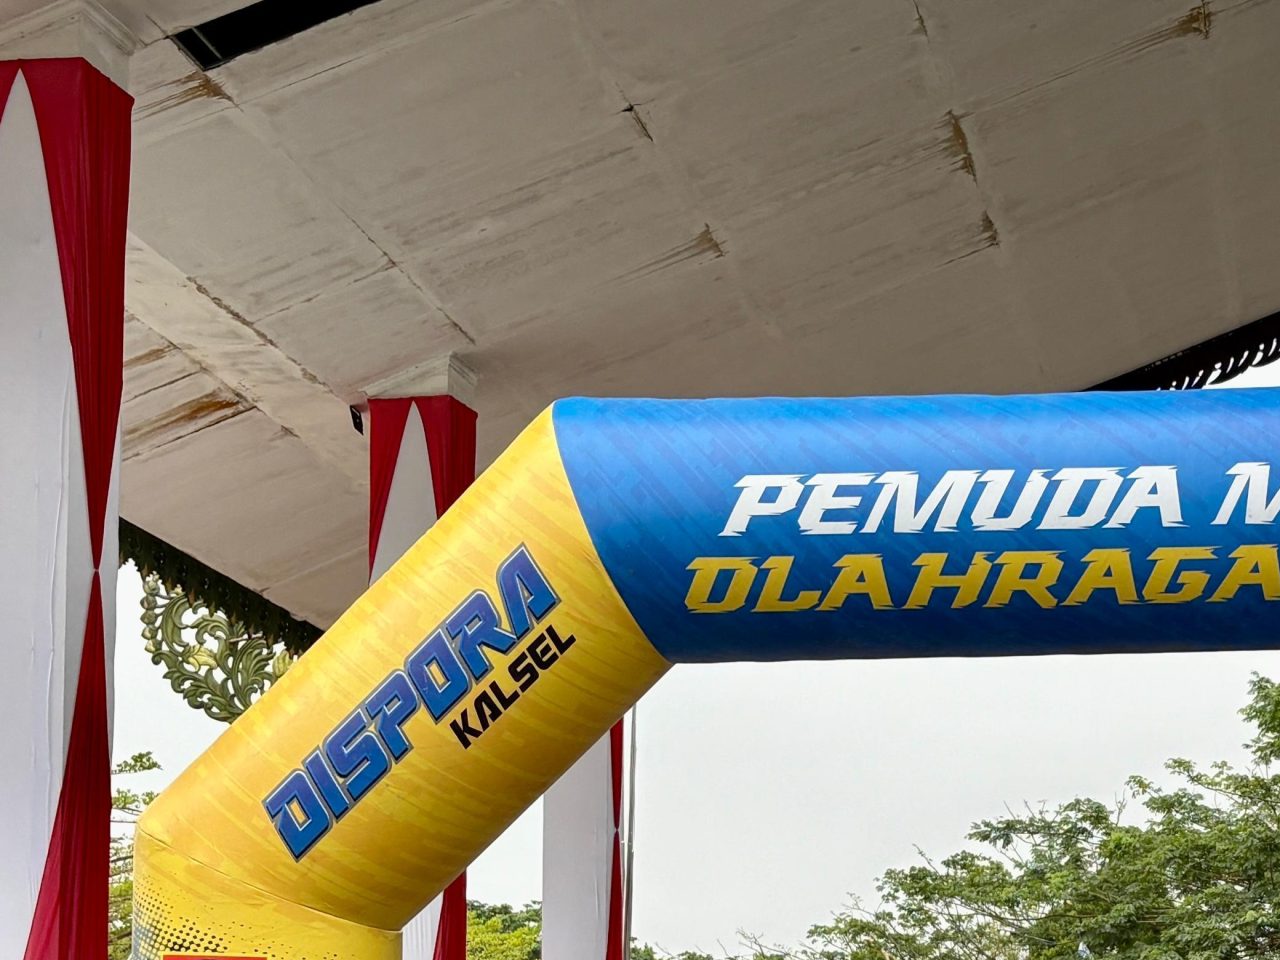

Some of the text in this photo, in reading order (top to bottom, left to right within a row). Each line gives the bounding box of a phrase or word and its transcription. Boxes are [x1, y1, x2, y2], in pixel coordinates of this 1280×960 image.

[719, 464, 1189, 537] PEMUDA
[261, 541, 562, 863] DISPORA
[449, 624, 577, 750] KALSEL
